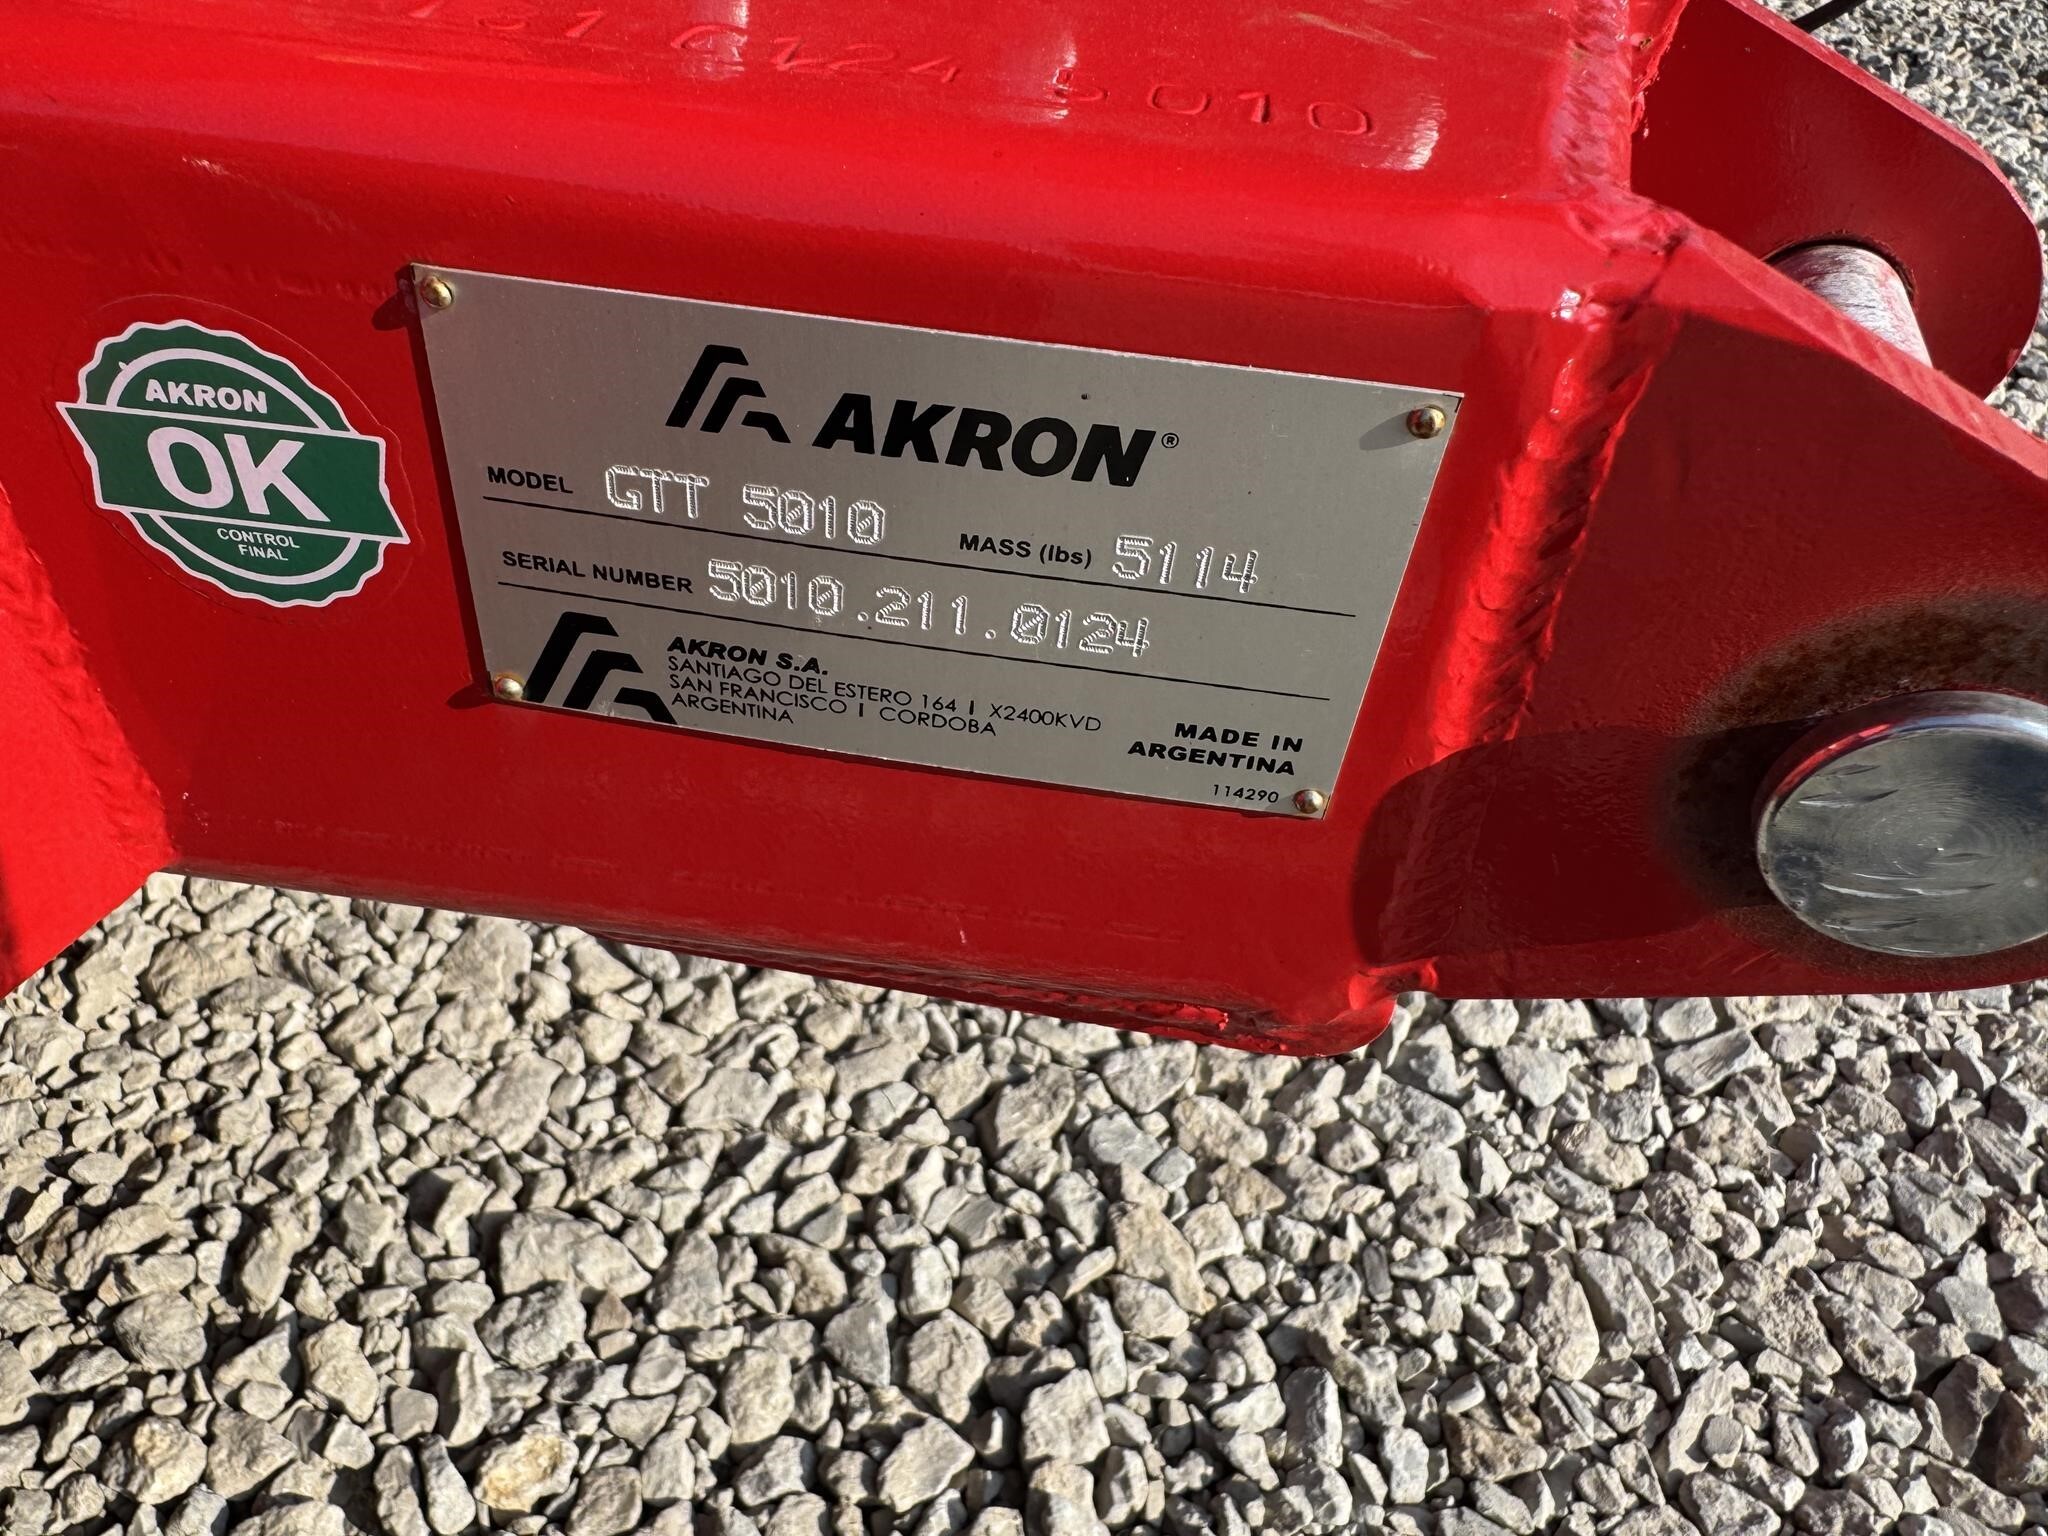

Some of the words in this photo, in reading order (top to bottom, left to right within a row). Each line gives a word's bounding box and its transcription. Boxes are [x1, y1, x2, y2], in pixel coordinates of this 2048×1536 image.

[145, 378, 267, 414] AKRON
[147, 426, 331, 523] OK
[487, 466, 573, 494] MODEL
[605, 464, 709, 518] GTT
[743, 483, 885, 545] 5010
[216, 527, 300, 549] CONTROL
[238, 543, 289, 561] FINAL
[959, 533, 1032, 559] MASS
[1039, 544, 1093, 569] (lbs)
[1112, 535, 1259, 594] 5114
[502, 550, 586, 578] SERIAL
[592, 564, 694, 594] NUMBER
[708, 558, 1150, 657] 5010.211.0124
[667, 636, 768, 666] AKRON
[775, 652, 829, 676] S.A.
[668, 655, 781, 687] SANTIAGO
[789, 674, 828, 694] DEL
[834, 681, 912, 706] ESTERO
[922, 694, 957, 713] 164
[989, 703, 1102, 732] X2400KVD
[670, 674, 712, 694] SAN
[720, 681, 848, 714] FRANCISCO
[879, 706, 996, 737] CORDOBA
[671, 692, 794, 725] ARGENTINA
[1174, 722, 1261, 748] MADE
[1271, 735, 1304, 753] IN
[1127, 741, 1295, 776] ARGENTINA
[1213, 784, 1280, 804] 114290
